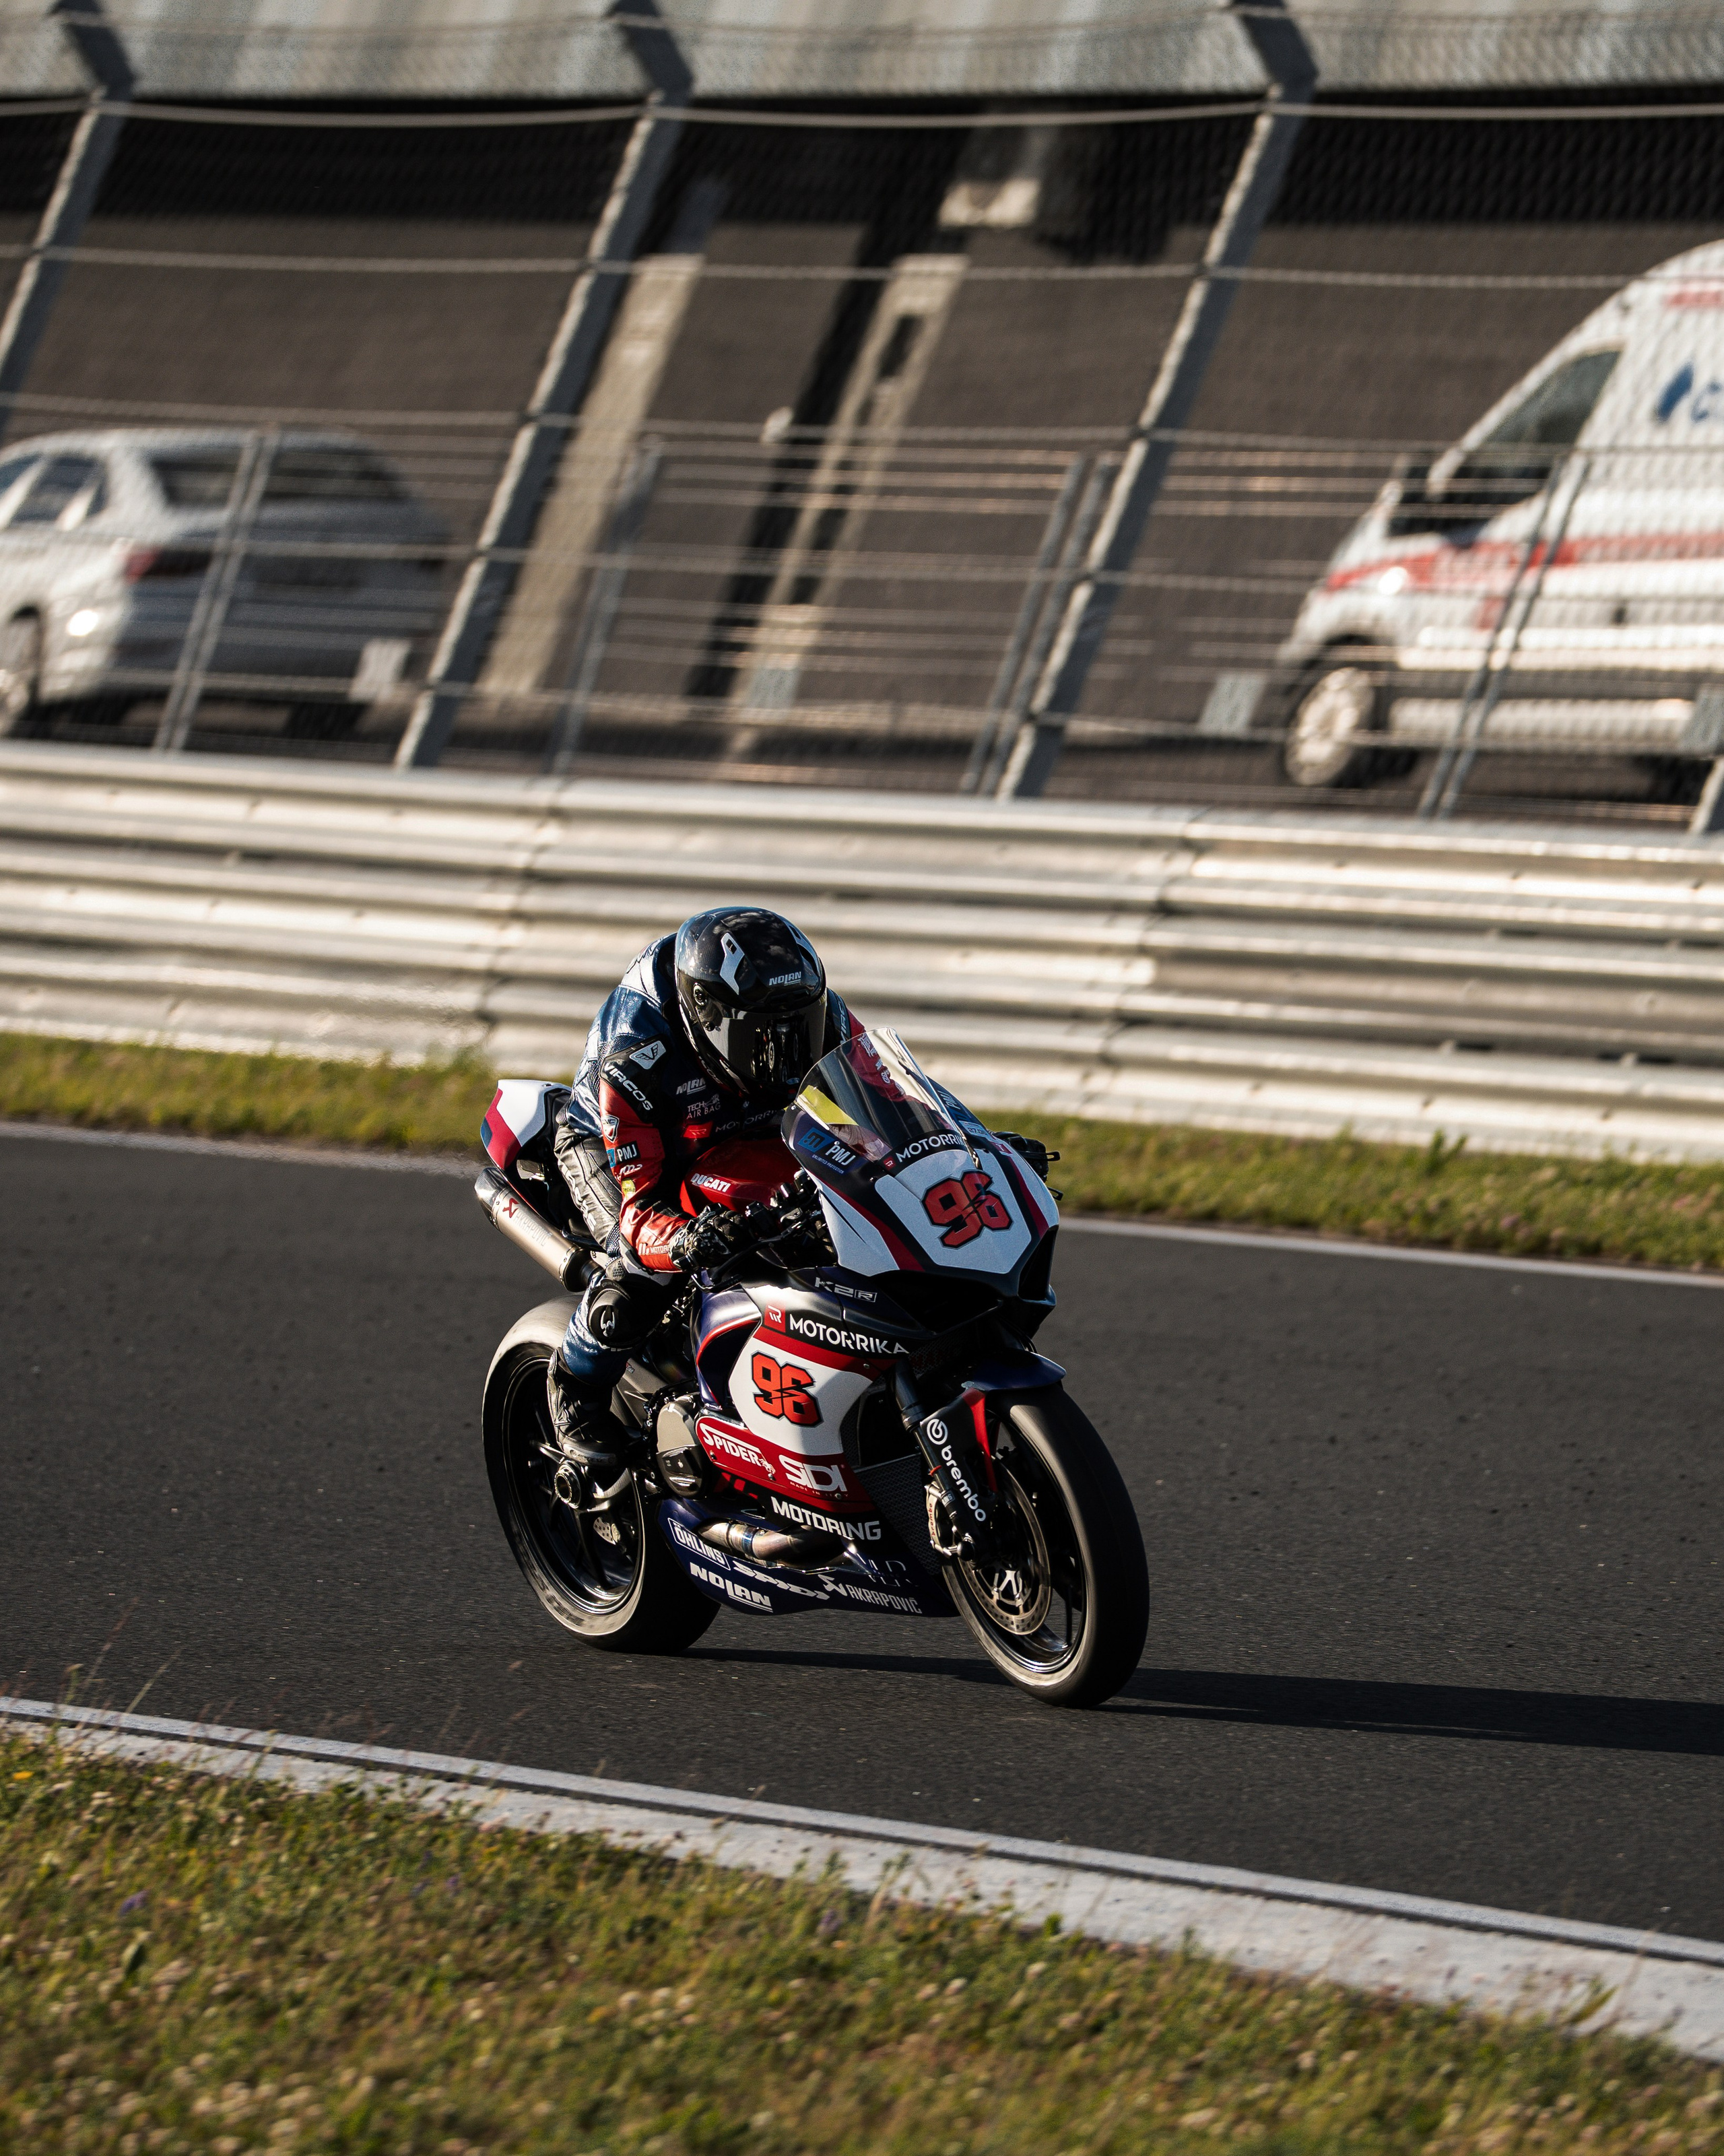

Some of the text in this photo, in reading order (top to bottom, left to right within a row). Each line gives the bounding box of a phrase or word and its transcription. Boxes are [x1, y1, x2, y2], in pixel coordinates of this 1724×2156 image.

[768, 971, 801, 986] NOLAN
[603, 1062, 653, 1111] VIRCOS
[686, 1102, 722, 1120] AIR BAG
[617, 1144, 637, 1161] PMJ
[825, 1144, 856, 1165] PMJ
[690, 1173, 731, 1192] DUCATI
[921, 1169, 1014, 1249] 96
[815, 1277, 877, 1303] K2R
[789, 1313, 909, 1354] MOTORRIKA
[752, 1351, 822, 1426] 96
[700, 1423, 762, 1467] SPIDER
[778, 1454, 848, 1493] SIDI
[941, 1445, 987, 1522] brembo
[770, 1496, 881, 1540] MOTORING
[690, 1562, 773, 1612] NOLAN
[732, 1560, 830, 1600] SPIDI
[845, 1584, 923, 1614] AKRAPOVIČ
